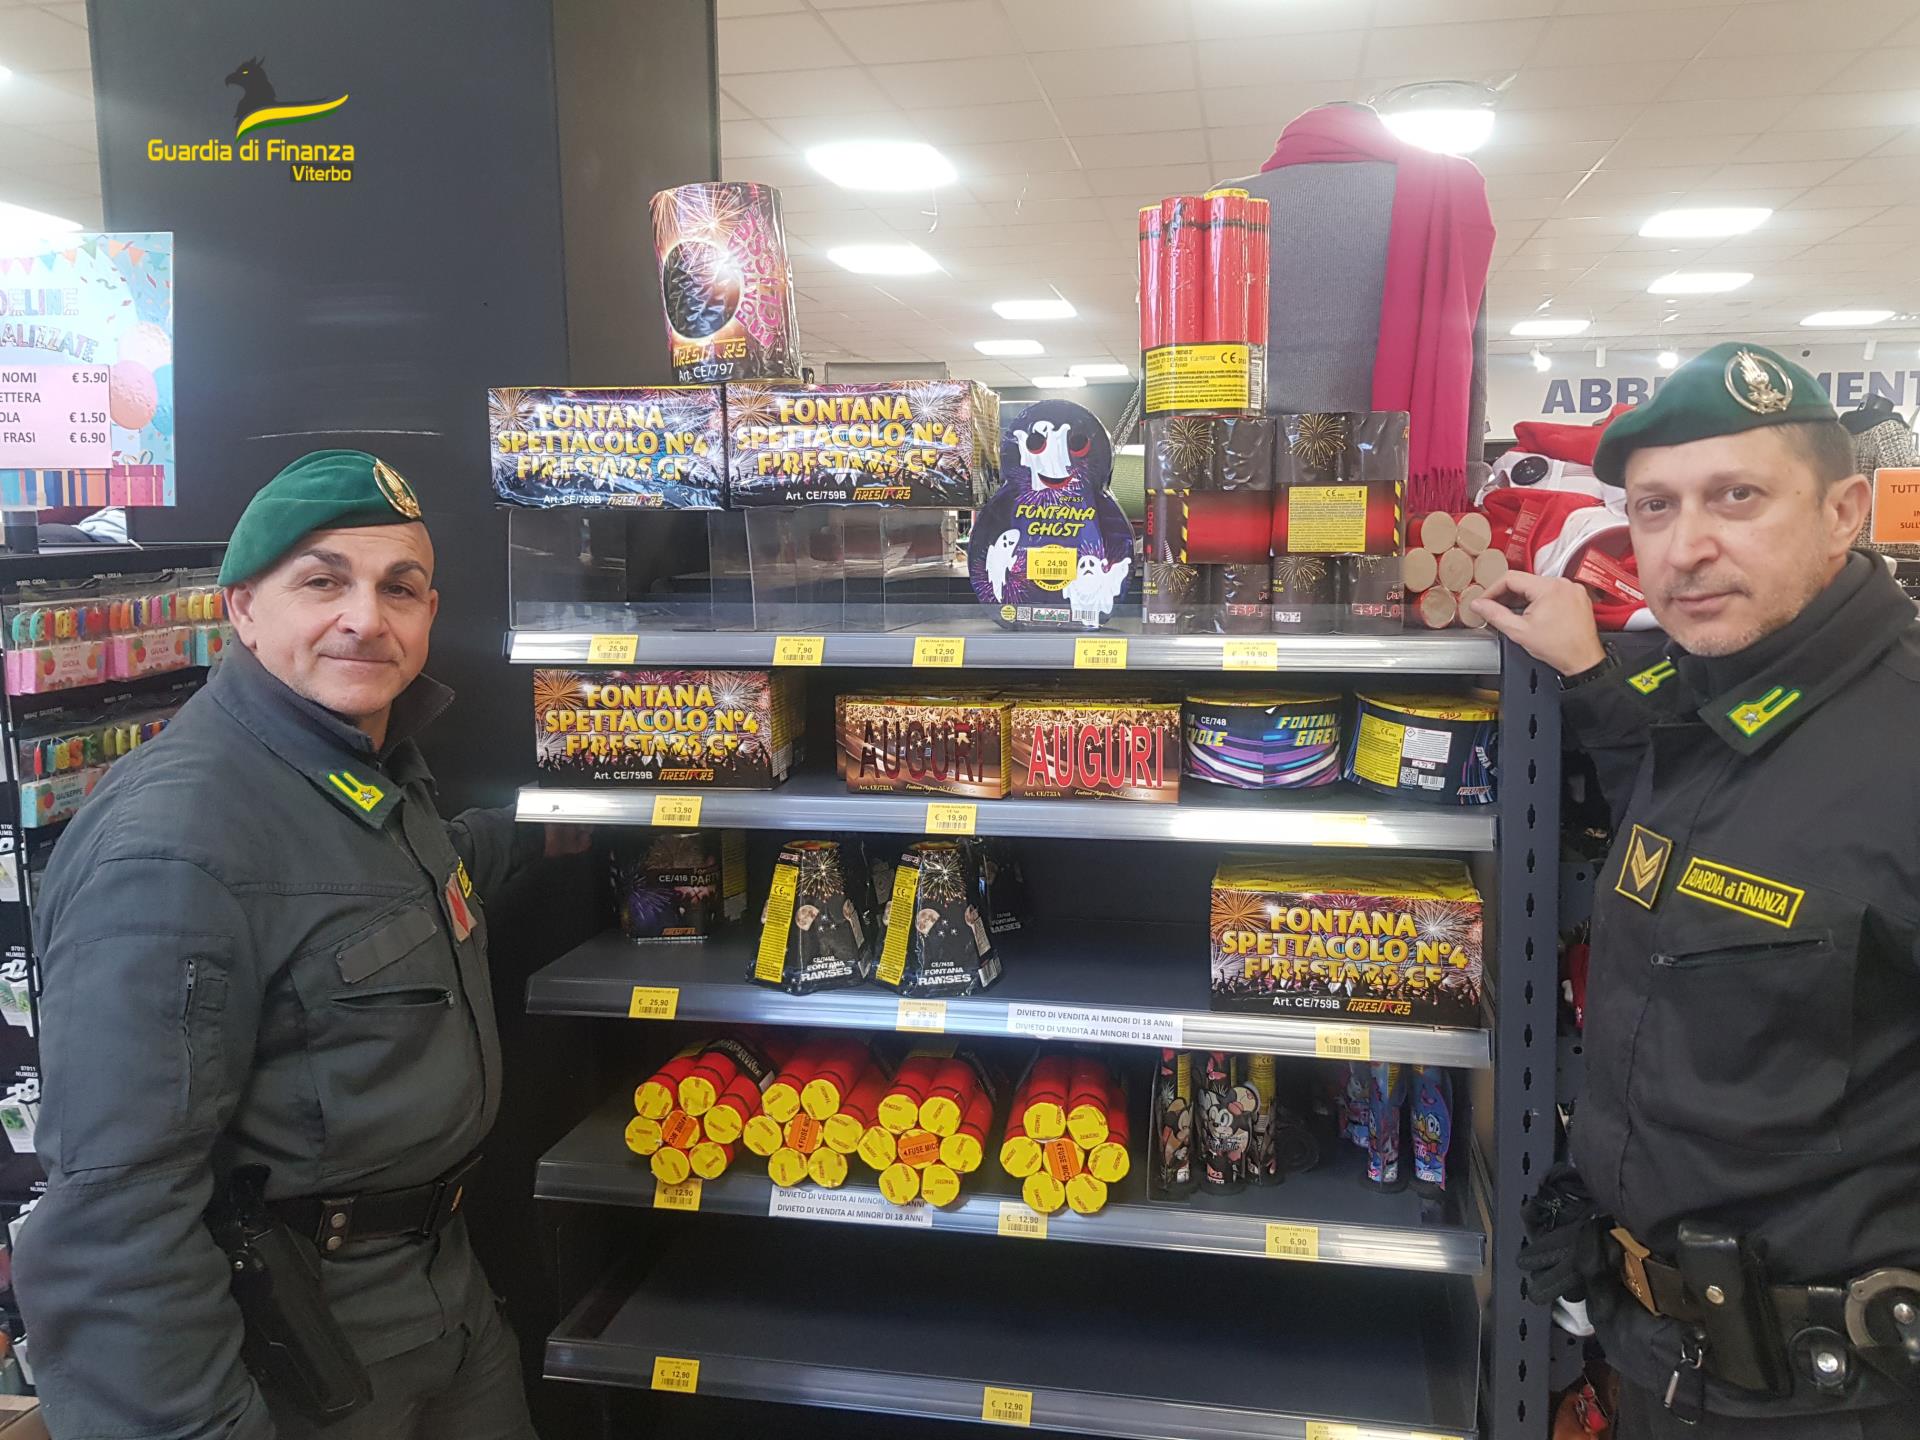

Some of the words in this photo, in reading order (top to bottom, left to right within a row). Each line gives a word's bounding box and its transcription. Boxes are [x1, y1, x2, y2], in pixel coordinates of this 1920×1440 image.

[735, 210, 781, 349] ECLISSE
[2, 372, 37, 384] NOMI
[72, 373, 79, 384] €
[82, 372, 108, 384] 5.90
[70, 412, 77, 423] €
[80, 412, 106, 423] 1.50
[536, 404, 666, 429] FONTANA
[779, 395, 913, 423] FONTANA
[3, 432, 36, 443] FRASI
[70, 432, 77, 443] €
[80, 432, 106, 443] 6.90
[498, 430, 660, 455] SPETTACOLO
[736, 422, 906, 451] SPETTACOLO
[543, 495, 560, 504] Art.
[785, 491, 803, 501] Art.
[805, 490, 847, 500] CE/759B
[1015, 503, 1096, 521] FONTANA
[1027, 521, 1086, 537] GHOST
[1047, 560, 1068, 568] 24,90
[586, 684, 715, 708] FONTANA
[545, 709, 709, 733] SPETTACOLO
[858, 719, 986, 784] AUGURI
[1026, 724, 1165, 789] AUGURI
[594, 770, 612, 780] Art.
[613, 770, 653, 780] CE/759B
[1687, 867, 1725, 898] GUARDIA
[1724, 882, 1737, 901] di
[1736, 881, 1789, 917] FINANZA
[1269, 906, 1418, 938] FONTANA
[1222, 930, 1409, 964] SPETTACOLO
[801, 966, 853, 982] RAMSES
[918, 973, 972, 986] RAMSES
[924, 966, 964, 976] FONTANA
[1272, 996, 1293, 1007] Art.
[1294, 996, 1341, 1010] CE/759B
[1016, 1008, 1046, 1018] DIVIETO
[1048, 1011, 1056, 1019] DI
[1057, 1012, 1090, 1021] VENDITA
[1101, 1015, 1131, 1025] MINORI
[1132, 1017, 1141, 1025] DI
[1143, 1018, 1152, 1026] 18
[1153, 1019, 1174, 1028] ANNI
[1016, 1022, 1045, 1032] DIVIETO
[1046, 1025, 1055, 1033] DI
[1056, 1025, 1089, 1035] VENDITA
[1090, 1028, 1099, 1036] AI
[1100, 1029, 1130, 1039] MINORI
[1132, 1031, 1140, 1040] DI
[1142, 1032, 1151, 1040] 18
[1152, 1033, 1173, 1042] ANNI
[907, 1145, 925, 1155] FUSE
[1057, 1146, 1068, 1164] FUSE
[779, 1190, 807, 1199] DIVIETO
[808, 1192, 816, 1200] DI
[818, 1193, 847, 1202] VENDITA
[858, 1196, 886, 1204] MINORI
[906, 1200, 925, 1208] ANNI
[777, 1203, 805, 1212] DIVIETO
[806, 1205, 814, 1213] DI
[816, 1206, 846, 1216] VENDITA
[856, 1210, 884, 1219] MINORI
[1290, 1237, 1307, 1246] 6,90
